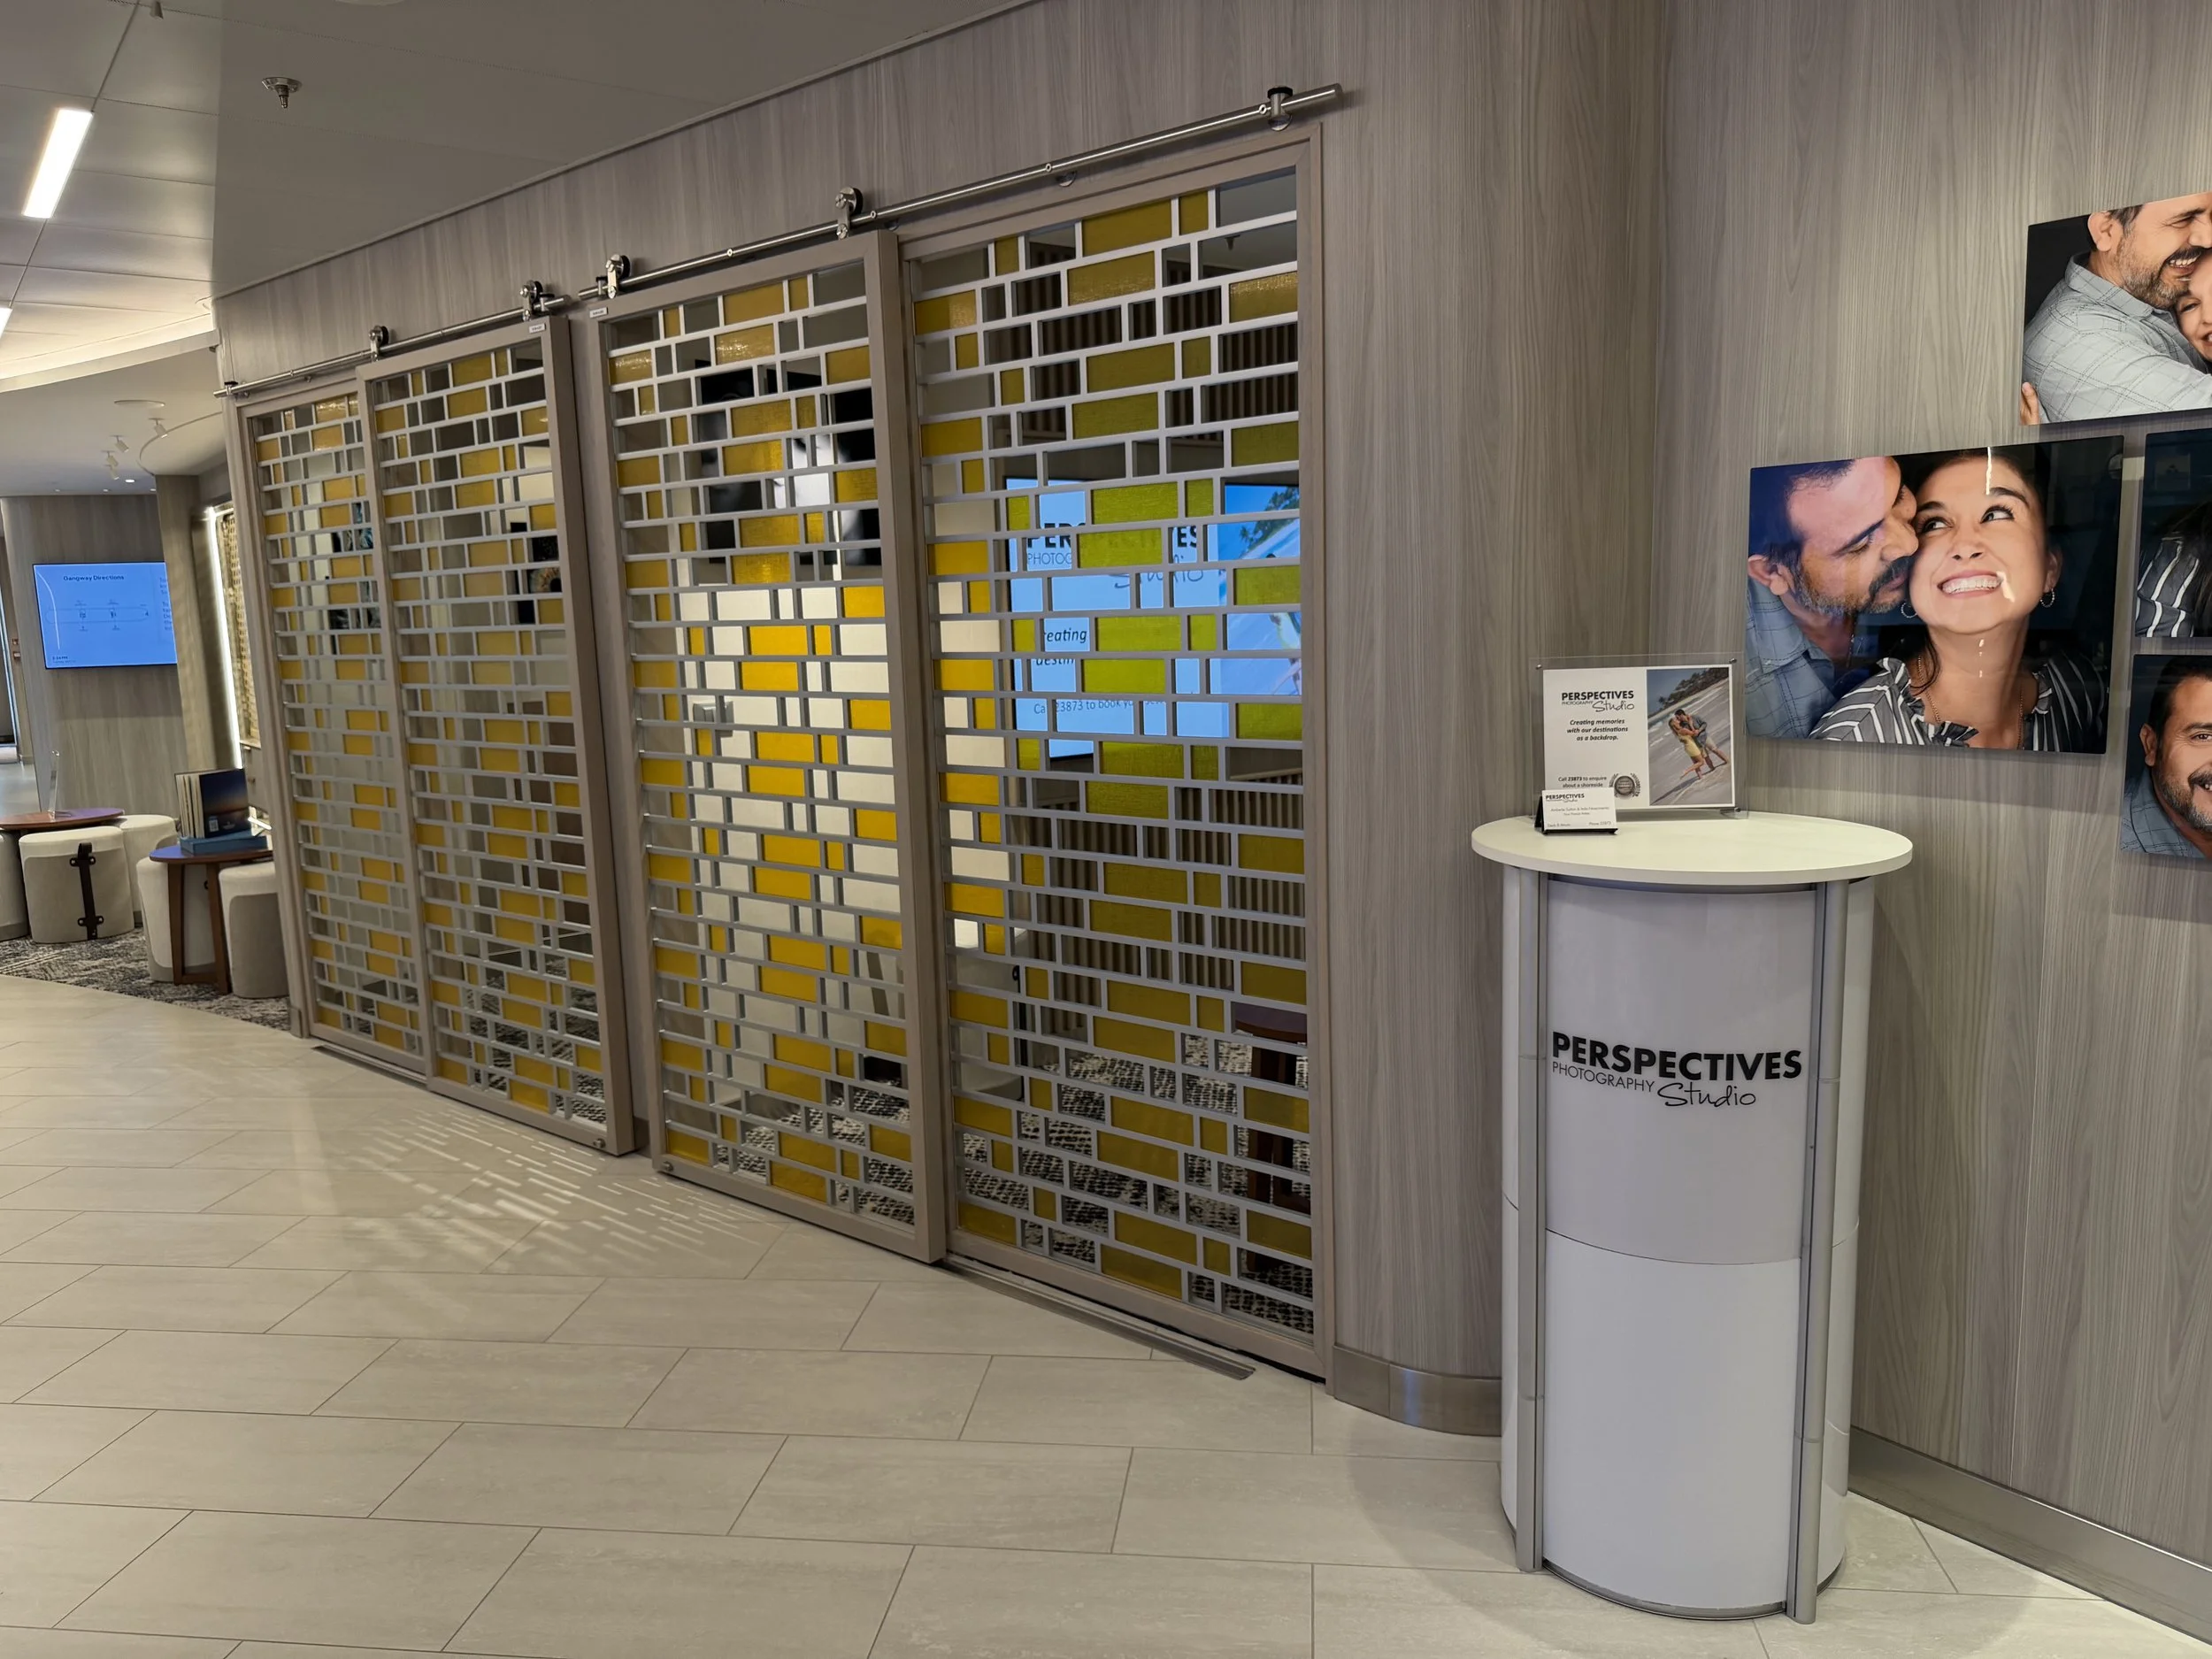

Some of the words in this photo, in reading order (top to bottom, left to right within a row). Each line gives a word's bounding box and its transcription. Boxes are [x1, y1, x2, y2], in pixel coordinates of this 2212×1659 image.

[1561, 690, 1634, 701] PERSPECTIVES
[1086, 700, 1095, 710] to
[1592, 700, 1635, 712] Studio
[1552, 1031, 1802, 1081] PERSPECTIVES
[1552, 1061, 1655, 1092] PHOTOGRAPHY
[1656, 1081, 1756, 1107] Studio
